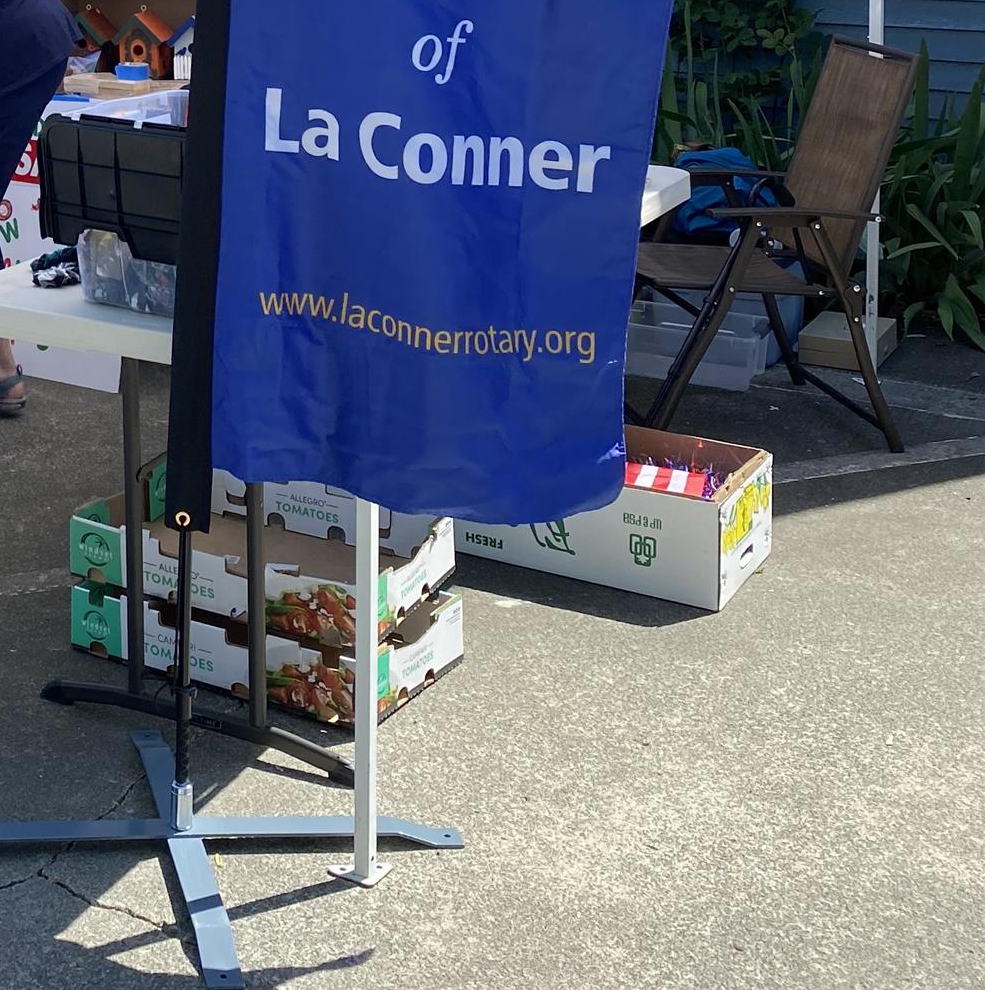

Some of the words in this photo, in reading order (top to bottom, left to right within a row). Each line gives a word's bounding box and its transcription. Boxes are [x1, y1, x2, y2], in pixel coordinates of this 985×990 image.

[411, 20, 474, 85] of
[264, 87, 340, 161] La
[358, 111, 611, 193] Conner
[259, 292, 596, 364] www.laconnerrotary.org
[275, 500, 340, 524] TOMATOES
[465, 530, 504, 550] FRESH
[158, 562, 200, 580] ALLEO
